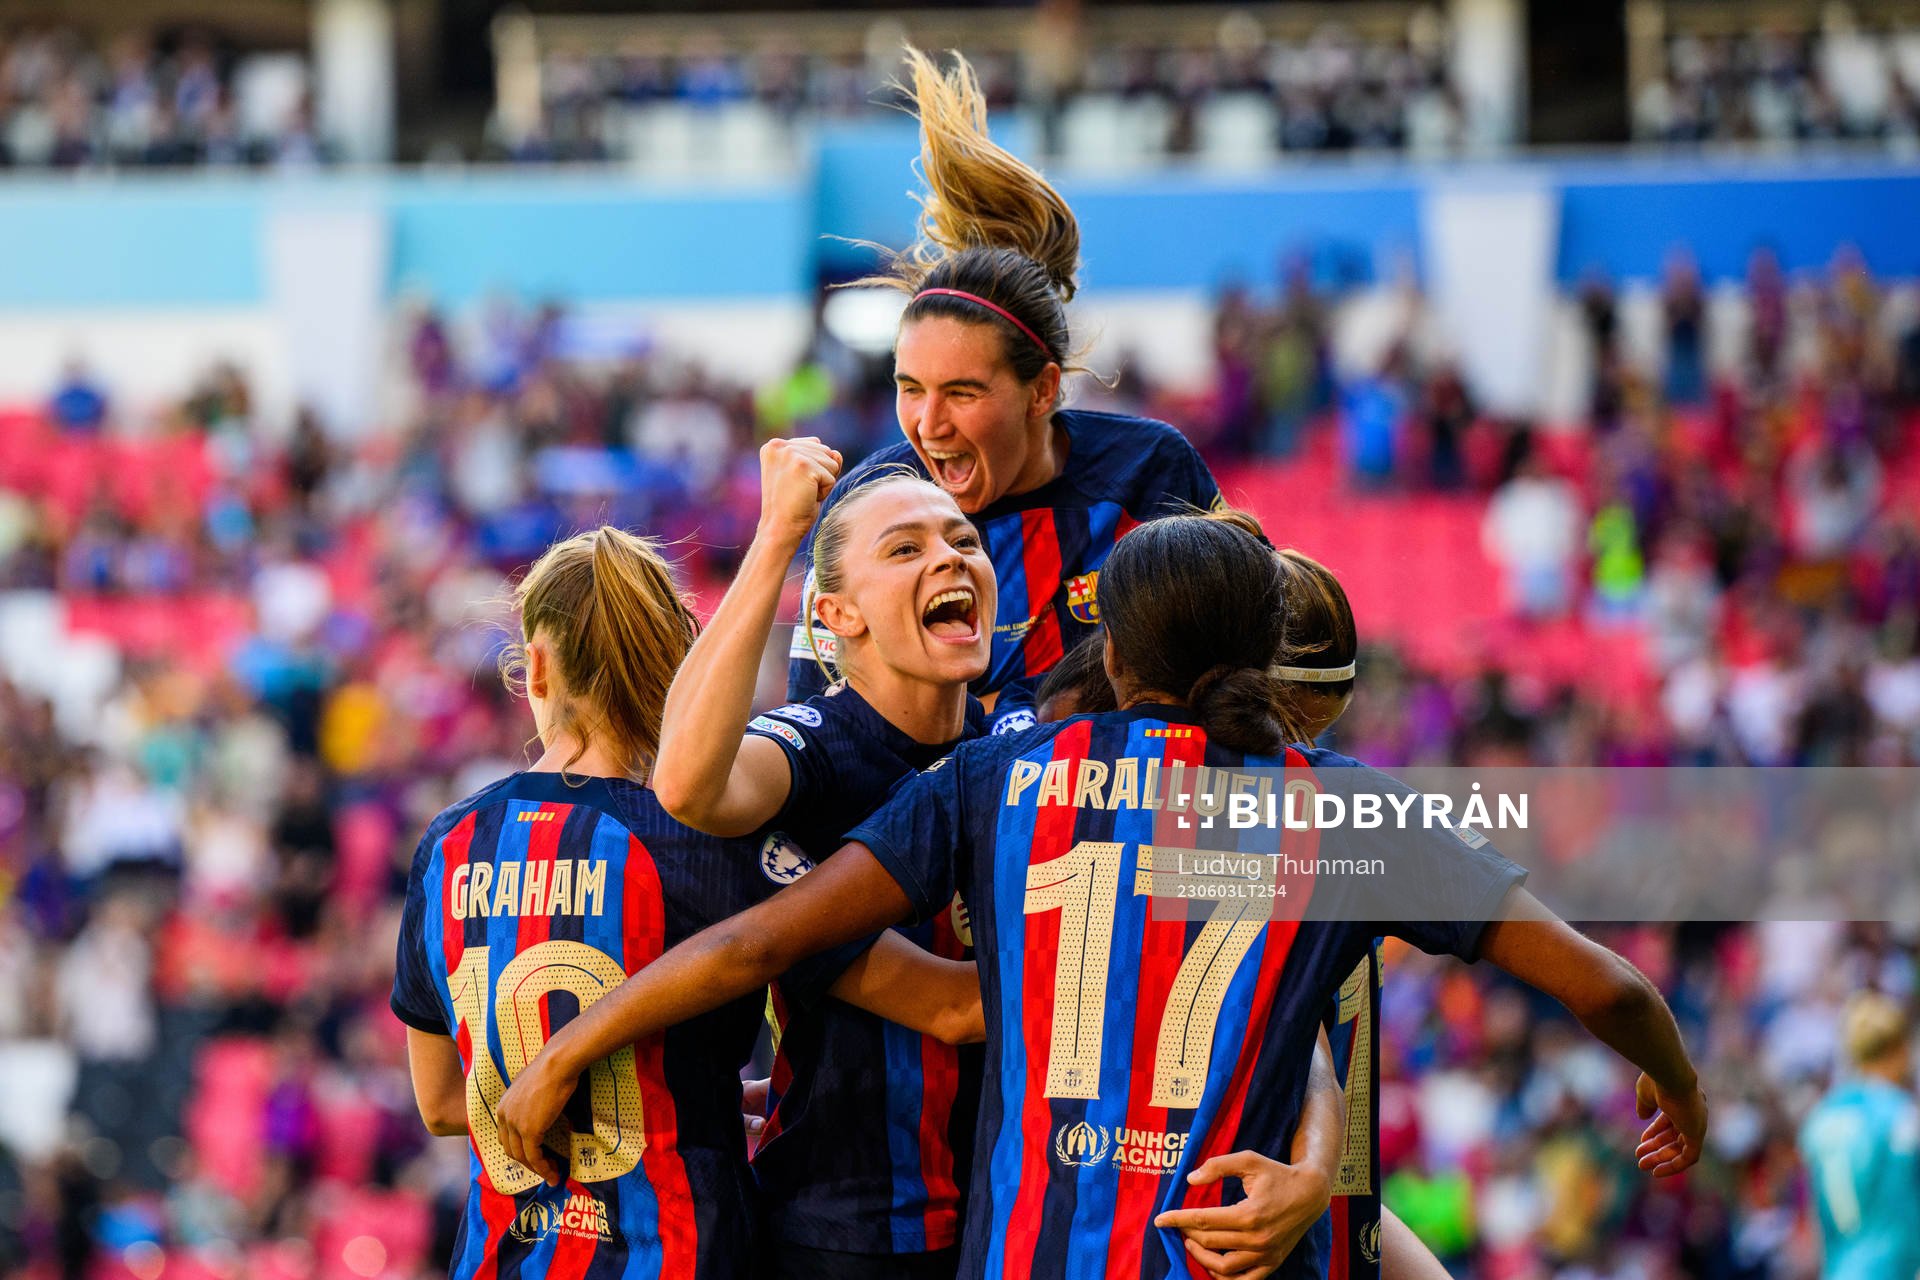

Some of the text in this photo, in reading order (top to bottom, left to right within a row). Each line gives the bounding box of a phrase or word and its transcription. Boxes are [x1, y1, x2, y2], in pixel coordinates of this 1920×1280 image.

[1006, 757, 1317, 832] PARALLUELO
[451, 859, 607, 920] GRAHAM
[1023, 841, 1277, 1109] 17
[447, 940, 647, 1195] 10
[1112, 1146, 1183, 1168] ACNU
